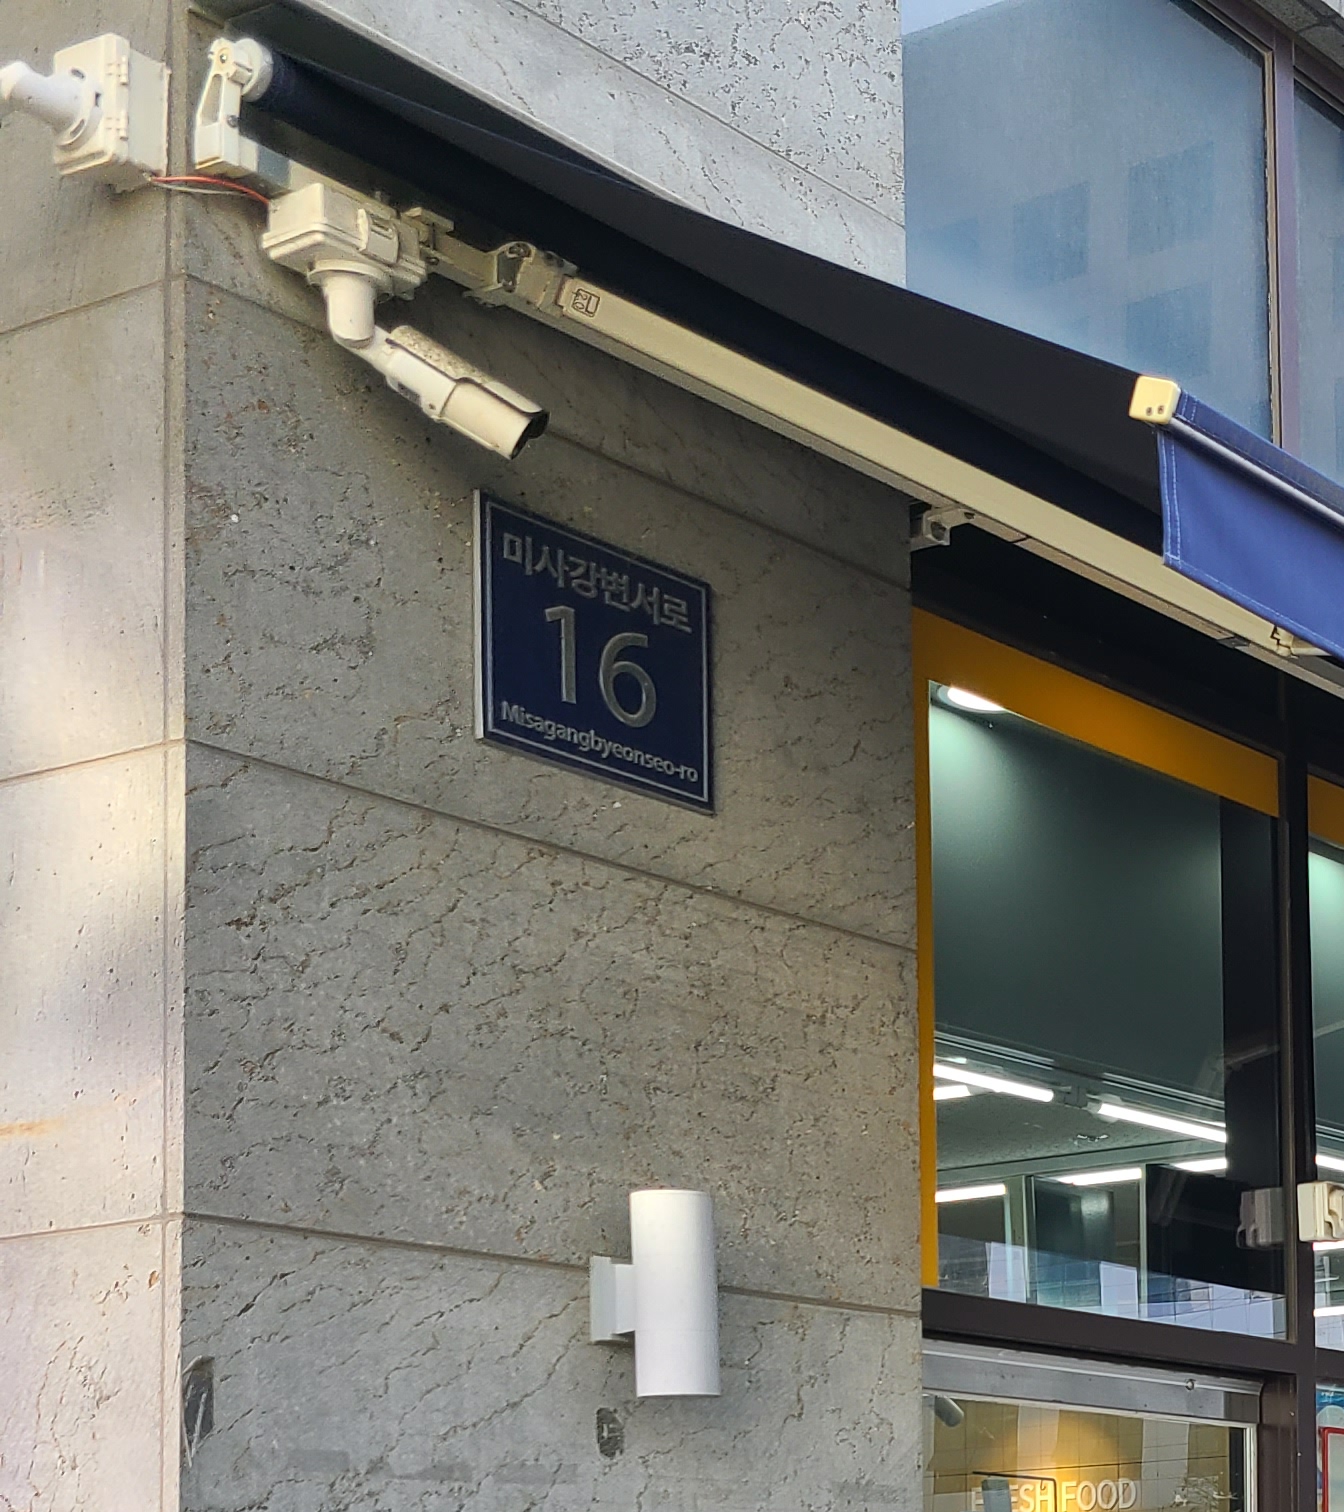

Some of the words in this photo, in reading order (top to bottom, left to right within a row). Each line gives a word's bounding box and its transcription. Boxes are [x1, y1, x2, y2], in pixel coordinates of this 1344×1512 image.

[502, 532, 692, 634] 미사강변서로
[545, 605, 656, 728] 16
[501, 700, 698, 782] Misagangbyeonseo-ro
[1062, 1478, 1137, 1512] FOOD
